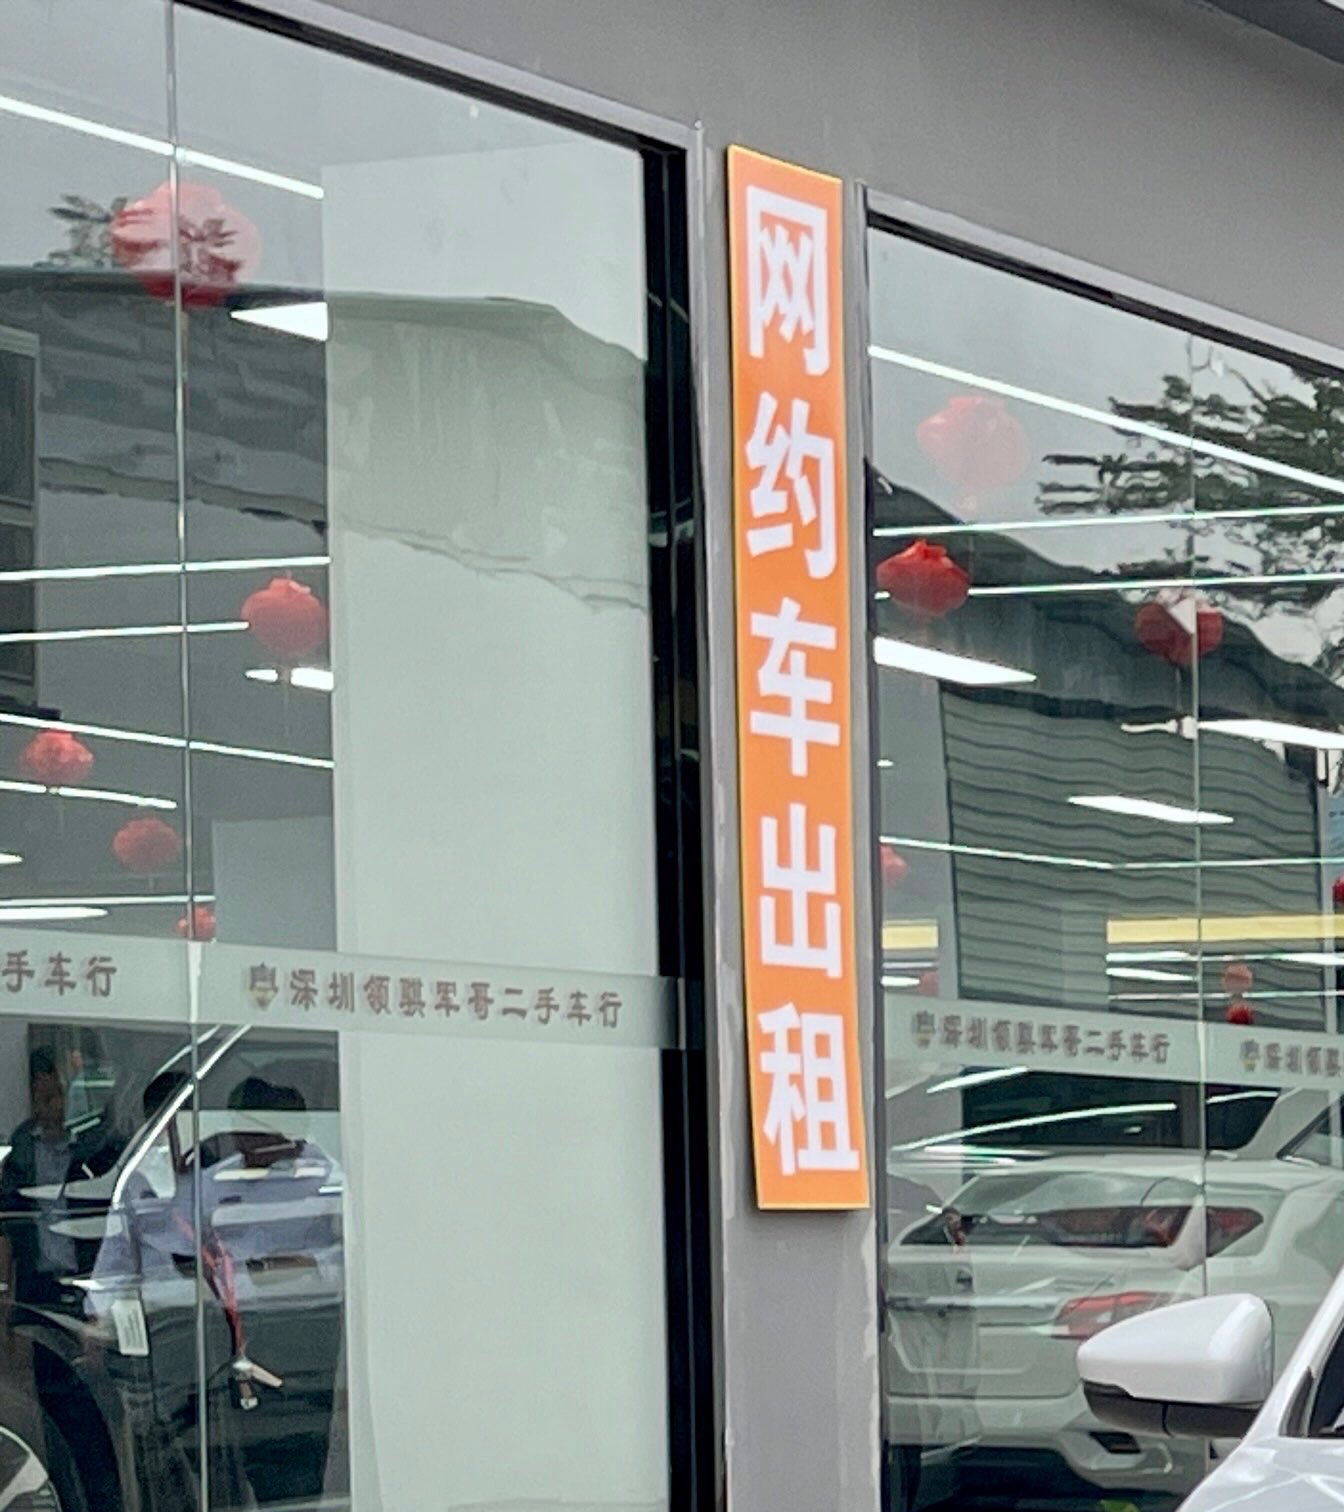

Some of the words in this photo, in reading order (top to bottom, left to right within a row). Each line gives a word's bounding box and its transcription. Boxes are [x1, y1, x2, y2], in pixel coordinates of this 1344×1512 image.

[744, 184, 860, 1176] 网约车出租
[1, 950, 117, 997] 手车行
